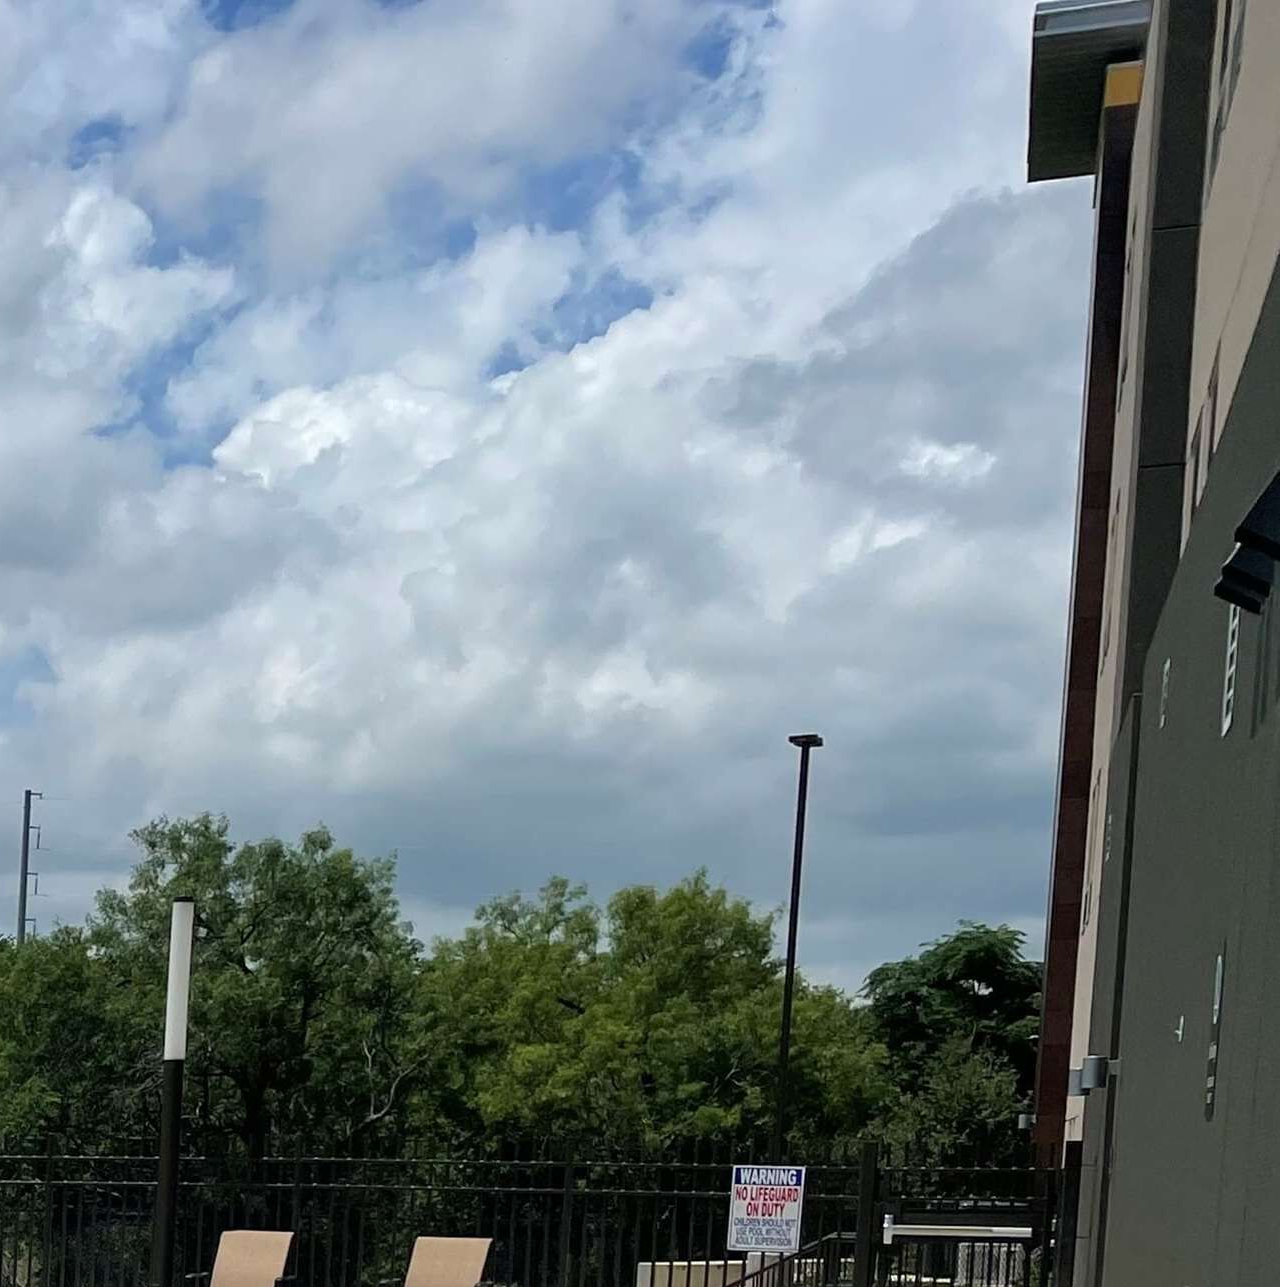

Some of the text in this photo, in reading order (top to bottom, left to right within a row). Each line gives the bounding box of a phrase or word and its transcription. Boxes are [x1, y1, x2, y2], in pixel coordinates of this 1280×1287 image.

[740, 1168, 797, 1185] WARNING
[735, 1186, 799, 1202] NO LIFEGUARD
[746, 1203, 785, 1217] ON DUTY
[734, 1217, 760, 1227] CHILDREN
[761, 1218, 784, 1227] SHOULD
[748, 1227, 764, 1236] POOL
[766, 1228, 791, 1237] WITHOUT
[754, 1237, 792, 1246] SUPERVISION
